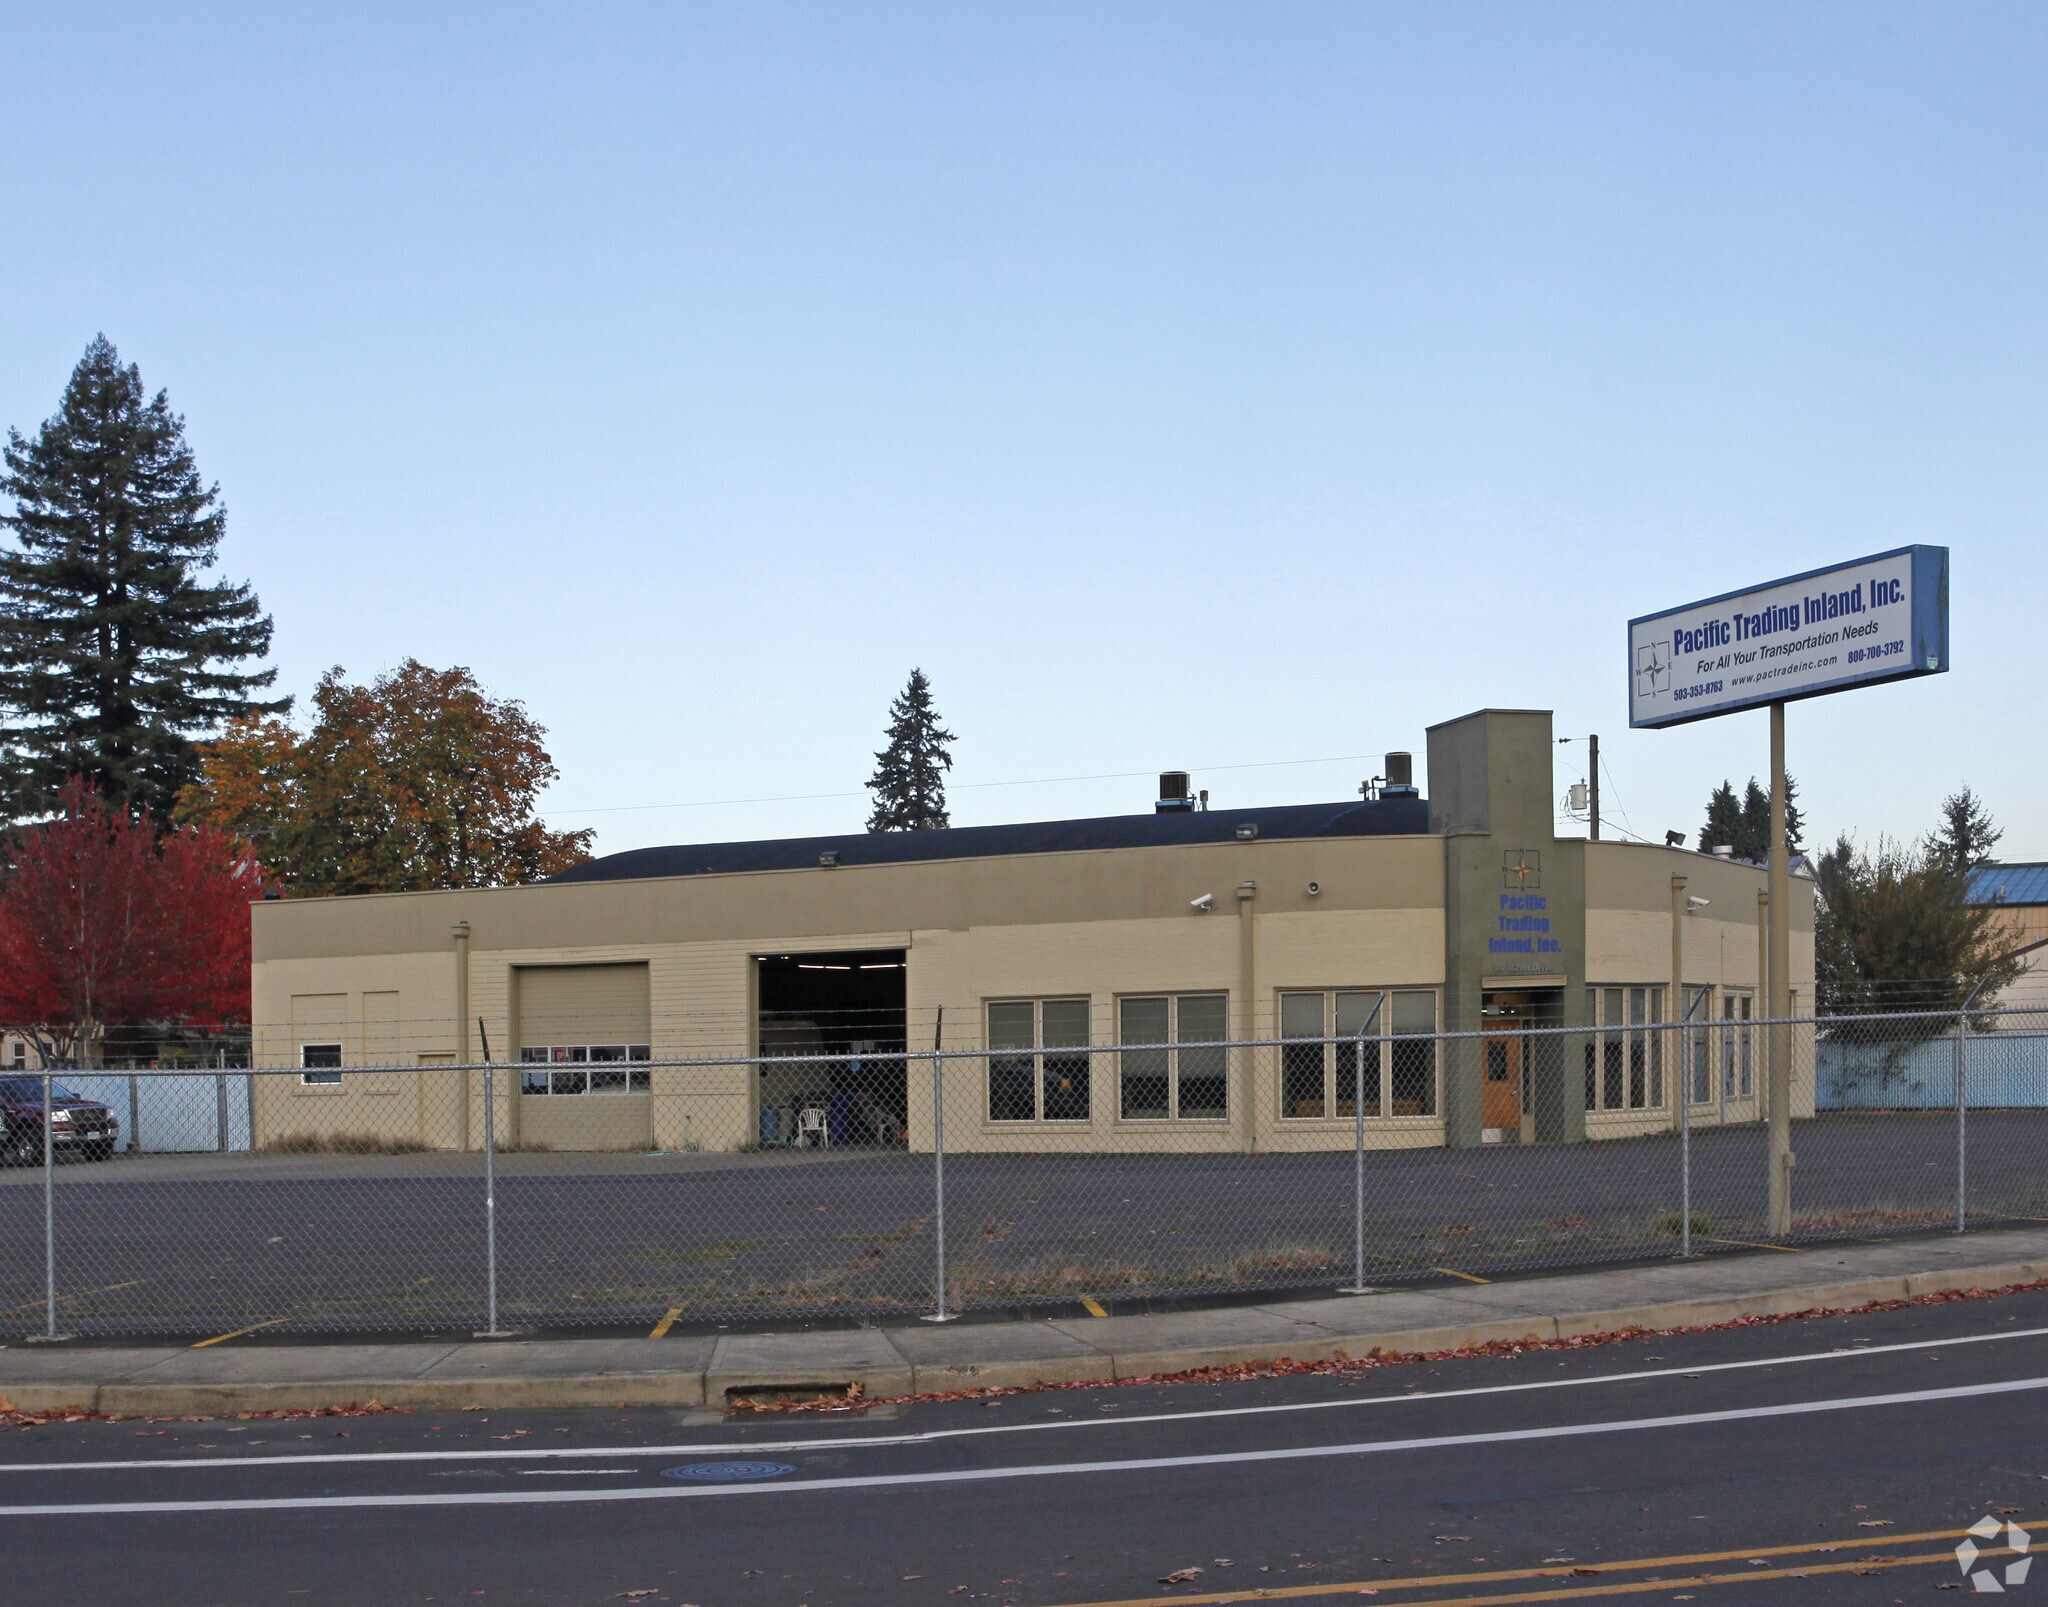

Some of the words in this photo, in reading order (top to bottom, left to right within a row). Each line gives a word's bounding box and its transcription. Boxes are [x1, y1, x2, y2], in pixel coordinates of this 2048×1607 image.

[1674, 619, 1731, 656] Pacific
[1733, 603, 1800, 642] Trading
[1804, 583, 1866, 625] Inland,
[1870, 578, 1905, 609] Inc.
[1697, 660, 1714, 674] For
[1716, 654, 1731, 670] All
[1733, 651, 1757, 666] Your
[1760, 631, 1839, 660] Transportation
[1842, 620, 1879, 641] Needs
[1673, 680, 1723, 701] 503-353-8763
[1731, 656, 1838, 687] www.pactradeinc.com
[1848, 640, 1904, 664] 800-700-3792
[1500, 894, 1547, 911] Pacific
[1498, 915, 1550, 933] Trading
[1537, 936, 1562, 953] Inc.
